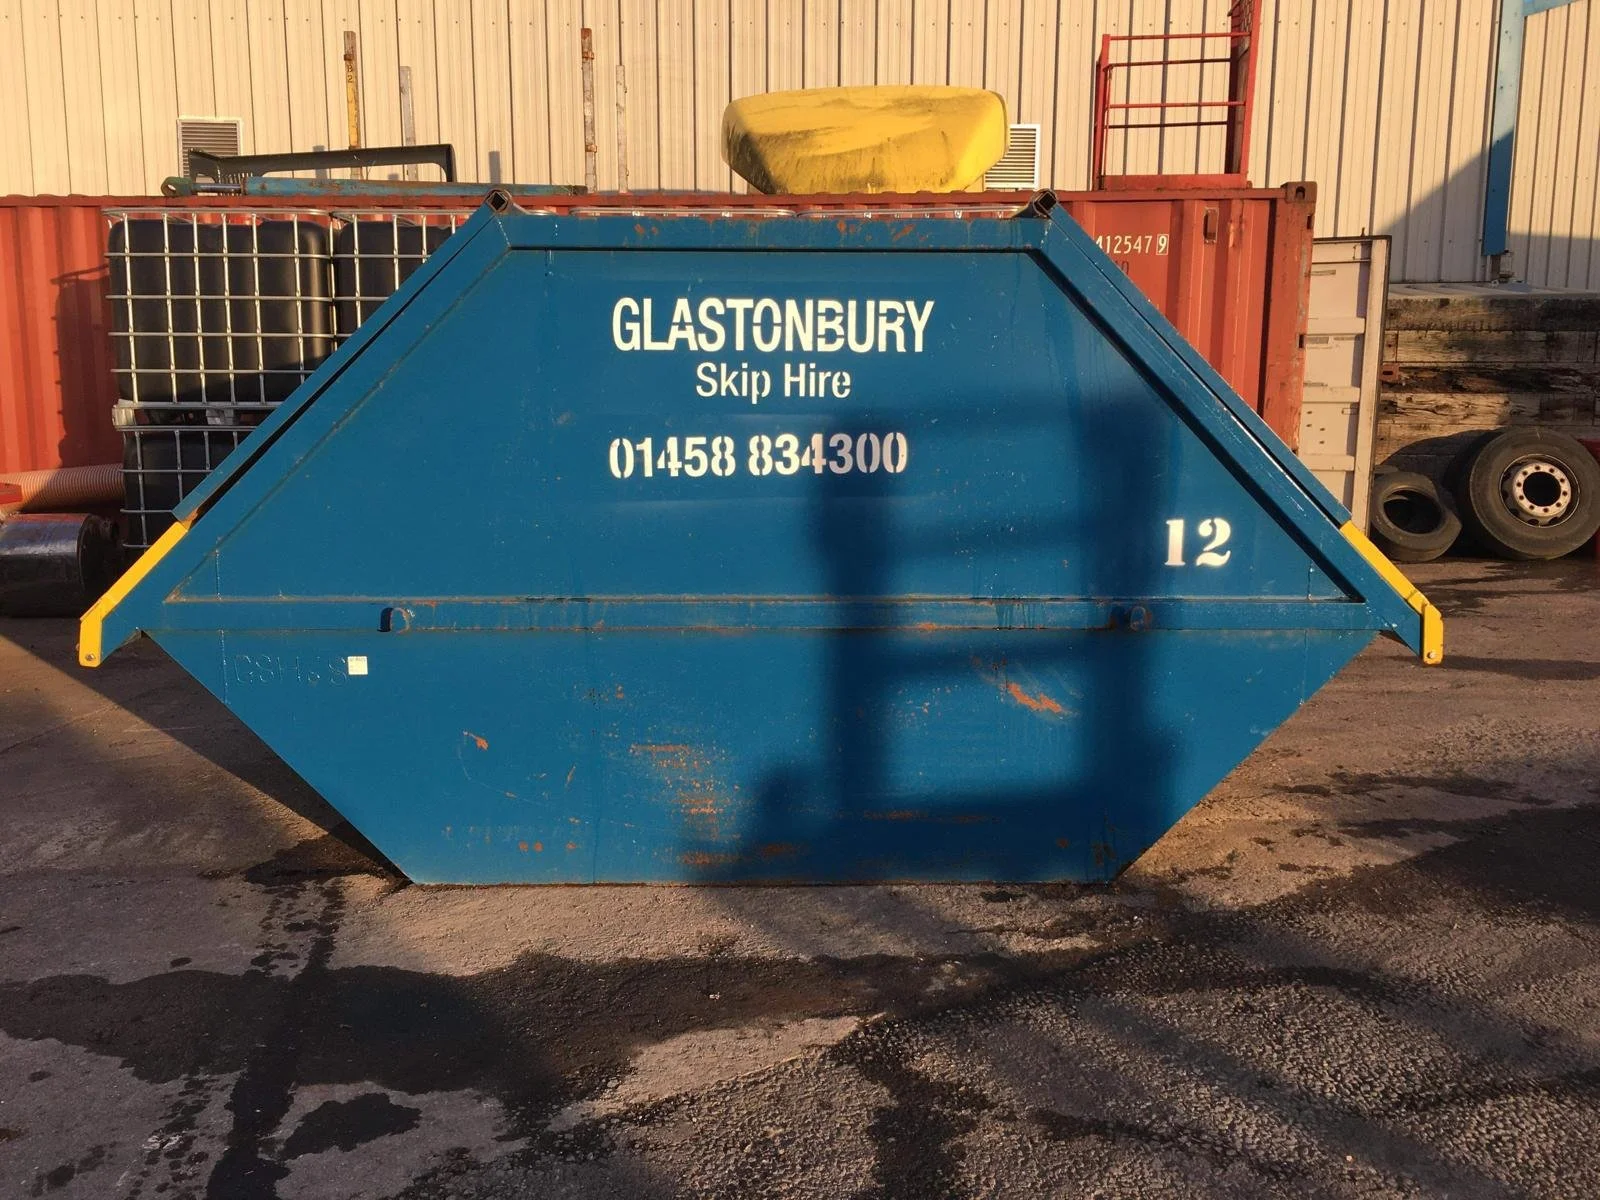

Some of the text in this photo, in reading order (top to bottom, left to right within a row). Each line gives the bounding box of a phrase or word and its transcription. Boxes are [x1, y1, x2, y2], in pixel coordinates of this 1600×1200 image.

[612, 297, 935, 353] GLASTONBURY
[695, 362, 851, 404] Skip Hire
[609, 432, 908, 479] 01458 834300
[1164, 517, 1231, 567] 12
